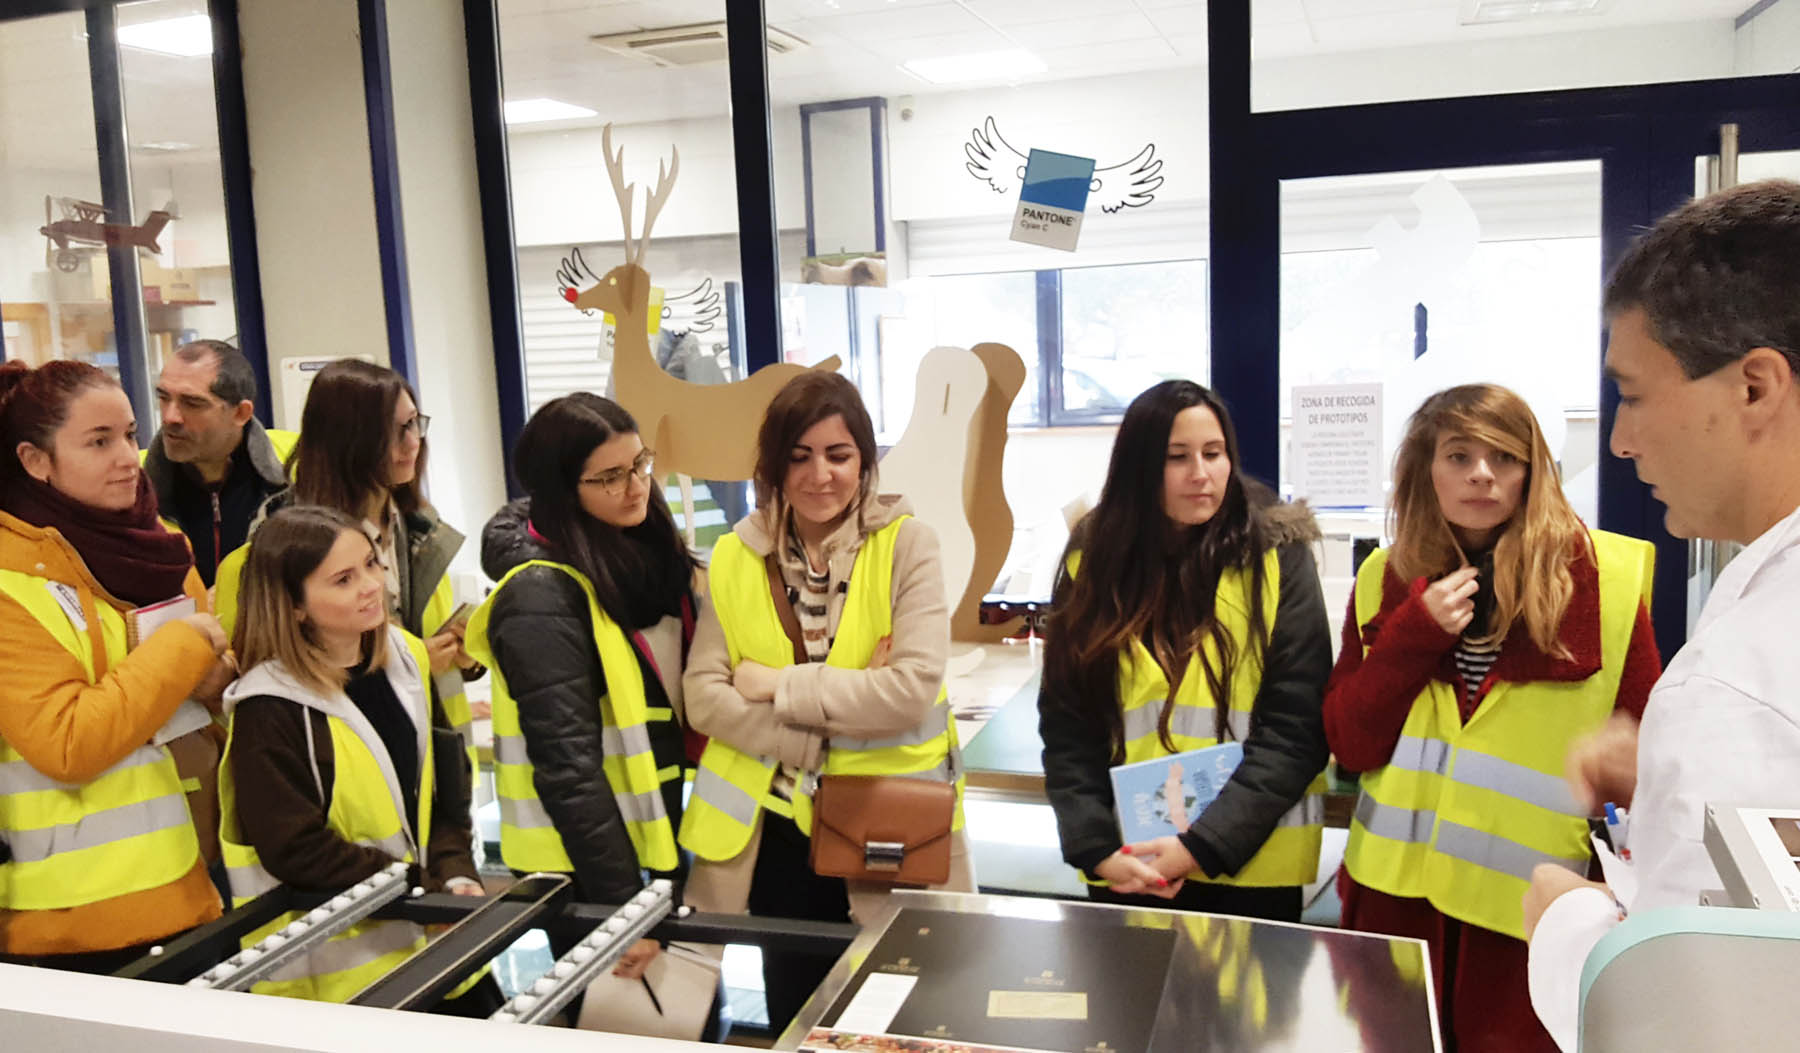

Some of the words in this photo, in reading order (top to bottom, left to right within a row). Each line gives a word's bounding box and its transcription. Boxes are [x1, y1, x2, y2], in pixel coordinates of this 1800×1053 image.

[1023, 208, 1073, 226] PANTONE
[1042, 224, 1049, 232] C
[1301, 397, 1322, 408] ZONA
[1324, 396, 1335, 407] DE
[1336, 395, 1375, 407] RECOGIDA
[1308, 414, 1319, 424] DE
[1320, 412, 1369, 424] PROTOTIPOS
